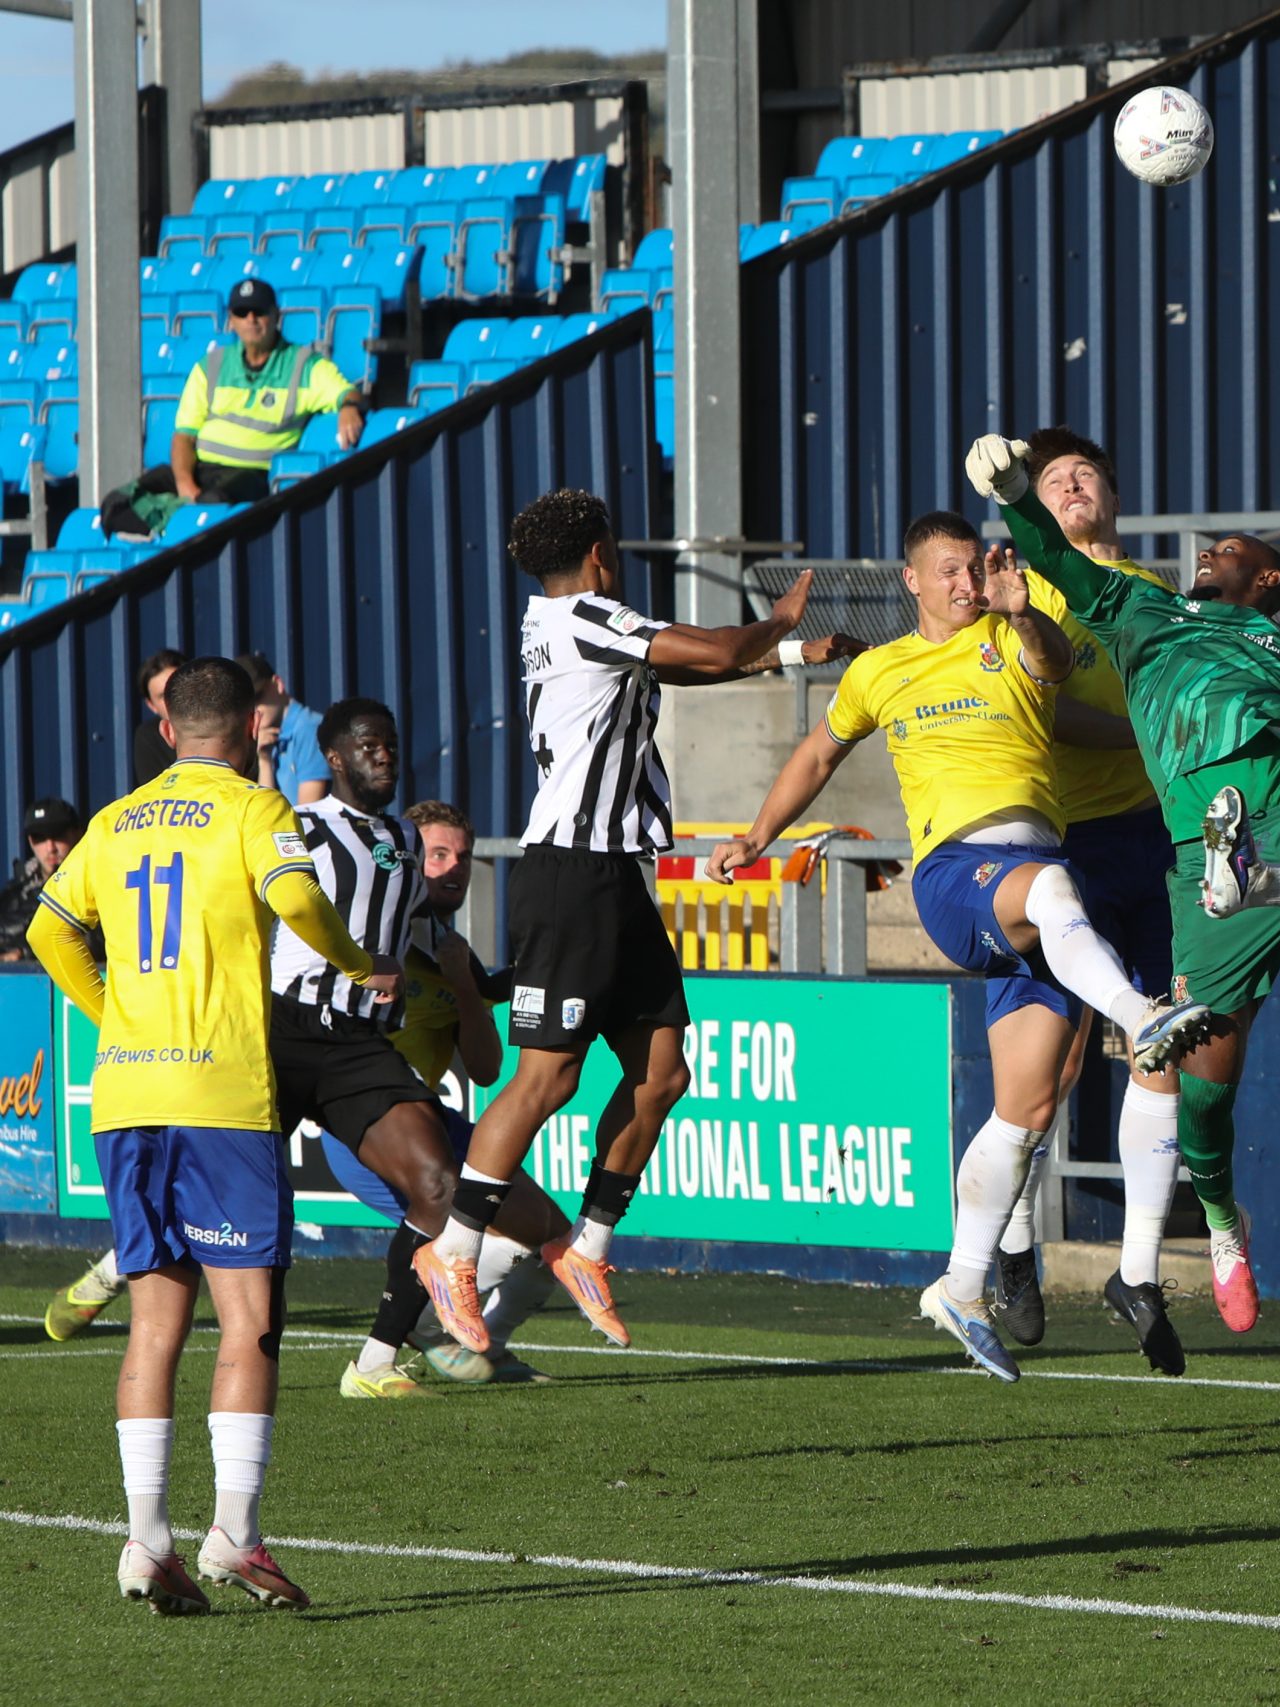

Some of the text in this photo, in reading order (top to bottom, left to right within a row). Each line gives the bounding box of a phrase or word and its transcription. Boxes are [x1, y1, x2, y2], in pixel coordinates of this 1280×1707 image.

[114, 799, 214, 833] CHESTERS
[125, 851, 184, 974] 11
[731, 1020, 797, 1102] FOR
[533, 1114, 590, 1193] THE
[779, 1122, 916, 1208] LEAGUE
